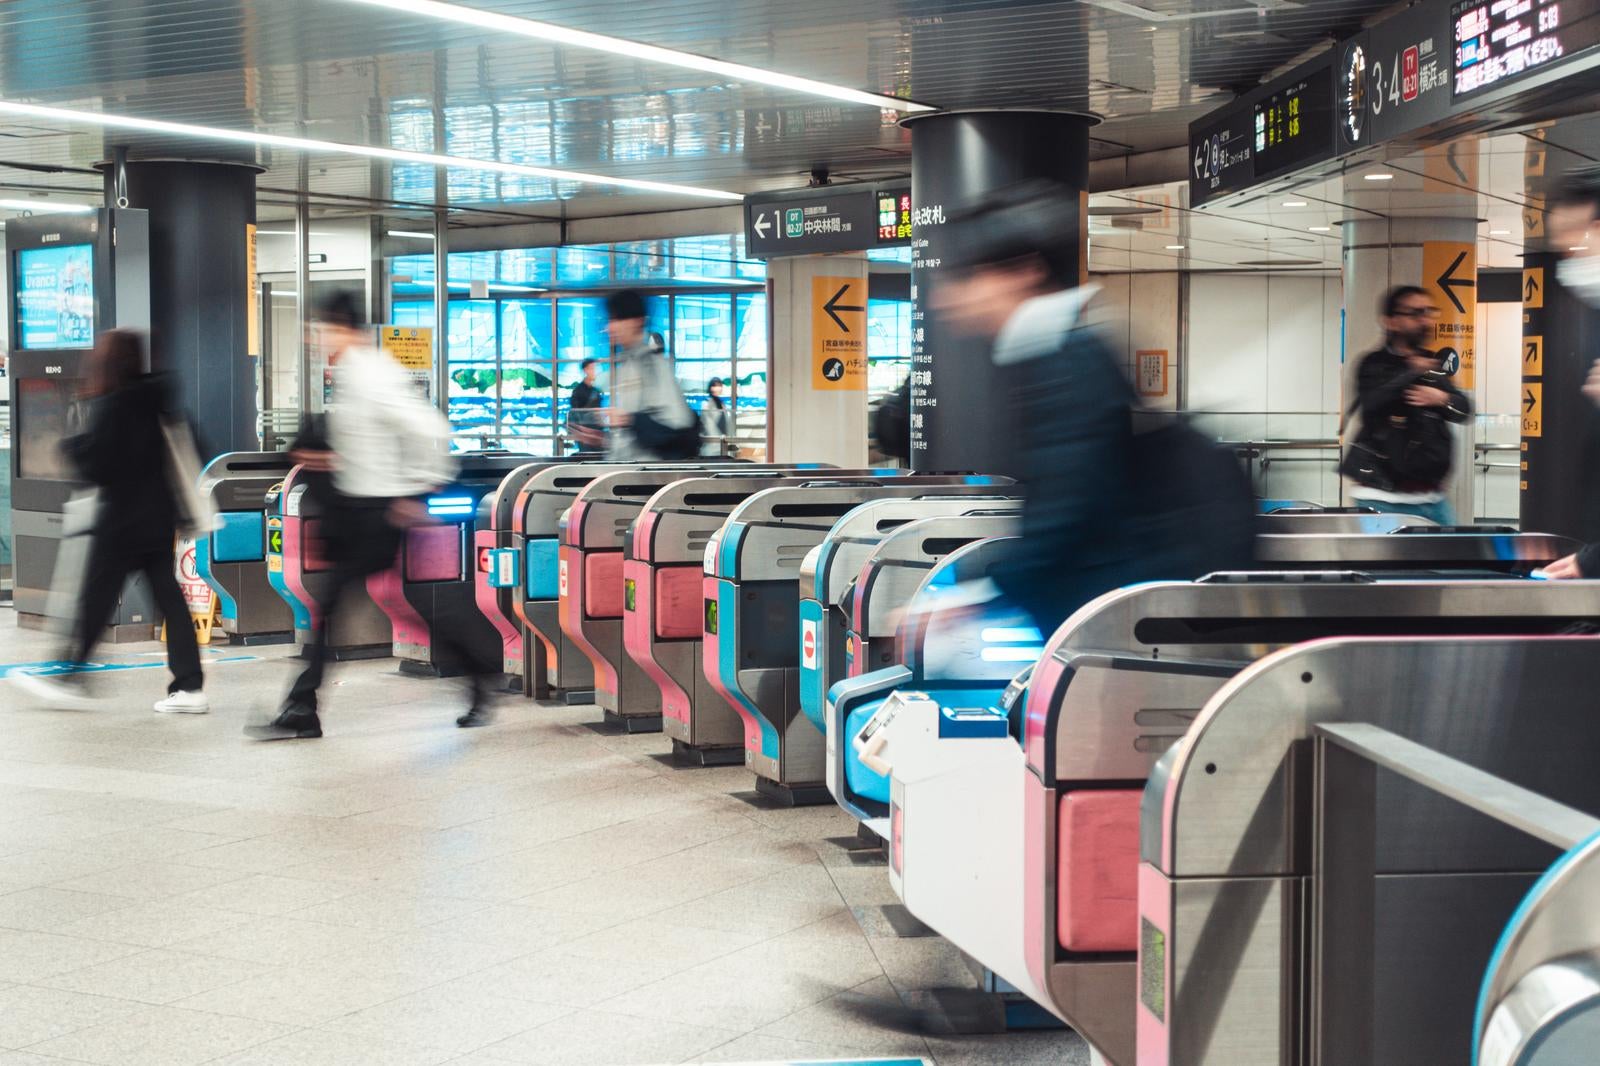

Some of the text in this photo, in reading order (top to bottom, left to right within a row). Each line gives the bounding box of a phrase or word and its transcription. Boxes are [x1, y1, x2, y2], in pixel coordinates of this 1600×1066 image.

[1406, 54, 1415, 70] TY
[1420, 60, 1437, 94] 横浜
[1203, 139, 1210, 179] 2
[774, 210, 781, 239] 1
[790, 212, 799, 221] DT
[804, 217, 841, 235] 中央林間
